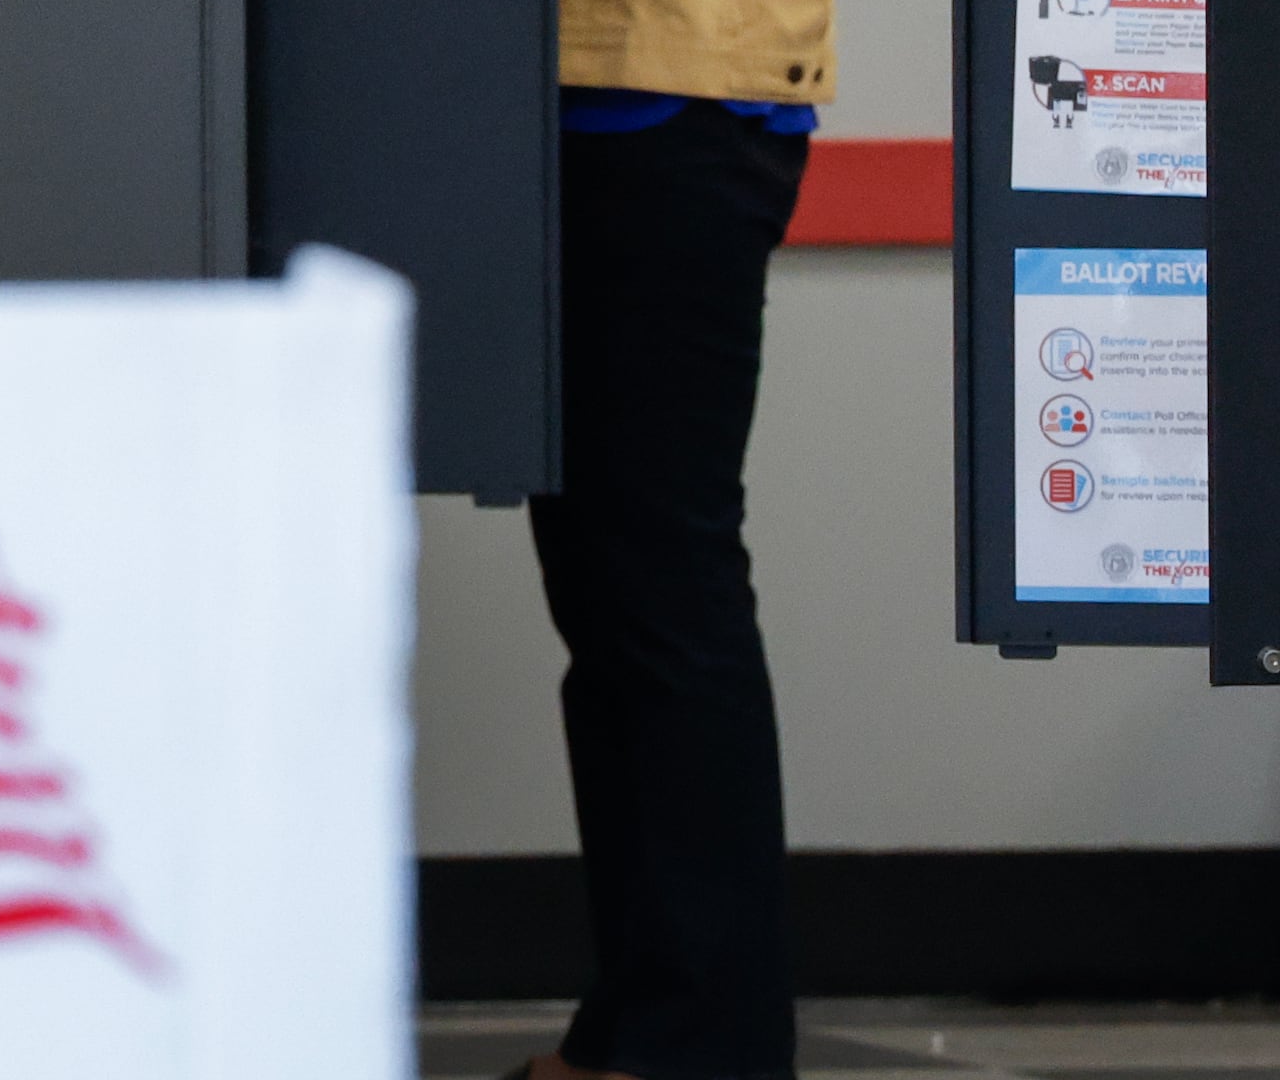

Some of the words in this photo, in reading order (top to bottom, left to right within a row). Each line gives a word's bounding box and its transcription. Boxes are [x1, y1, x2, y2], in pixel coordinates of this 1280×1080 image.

[1093, 74, 1108, 91] 3.
[1112, 74, 1166, 92] SCAN
[1137, 169, 1165, 182] THE
[1061, 261, 1152, 284] BALLOT
